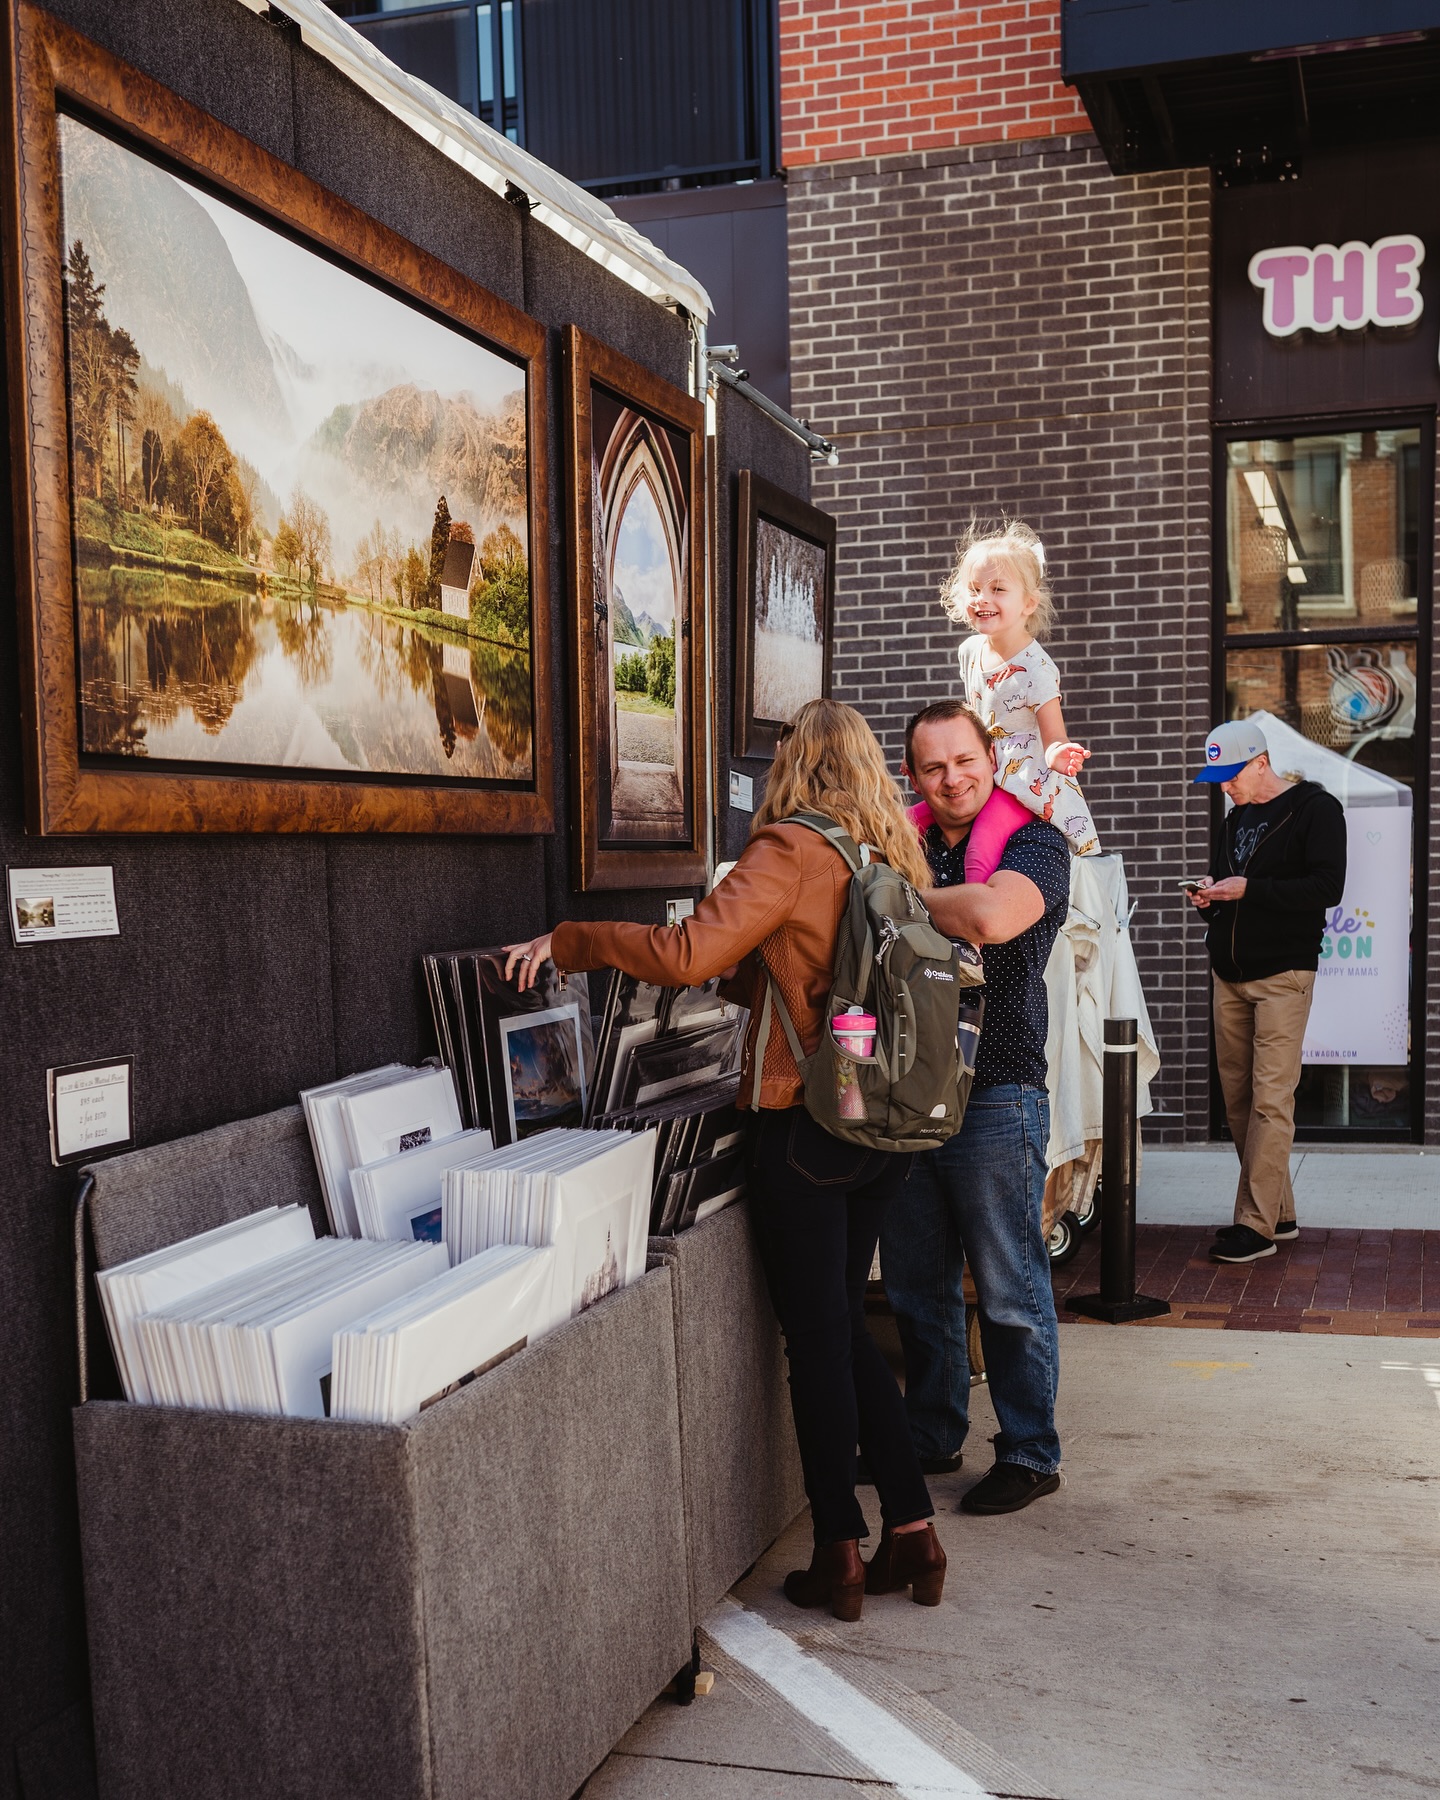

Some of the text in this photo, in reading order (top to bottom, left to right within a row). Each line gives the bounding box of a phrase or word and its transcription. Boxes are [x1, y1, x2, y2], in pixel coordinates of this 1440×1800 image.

[1254, 241, 1419, 330] THE
[1347, 967, 1379, 977] MAMAS
[91, 1091, 105, 1103] each
